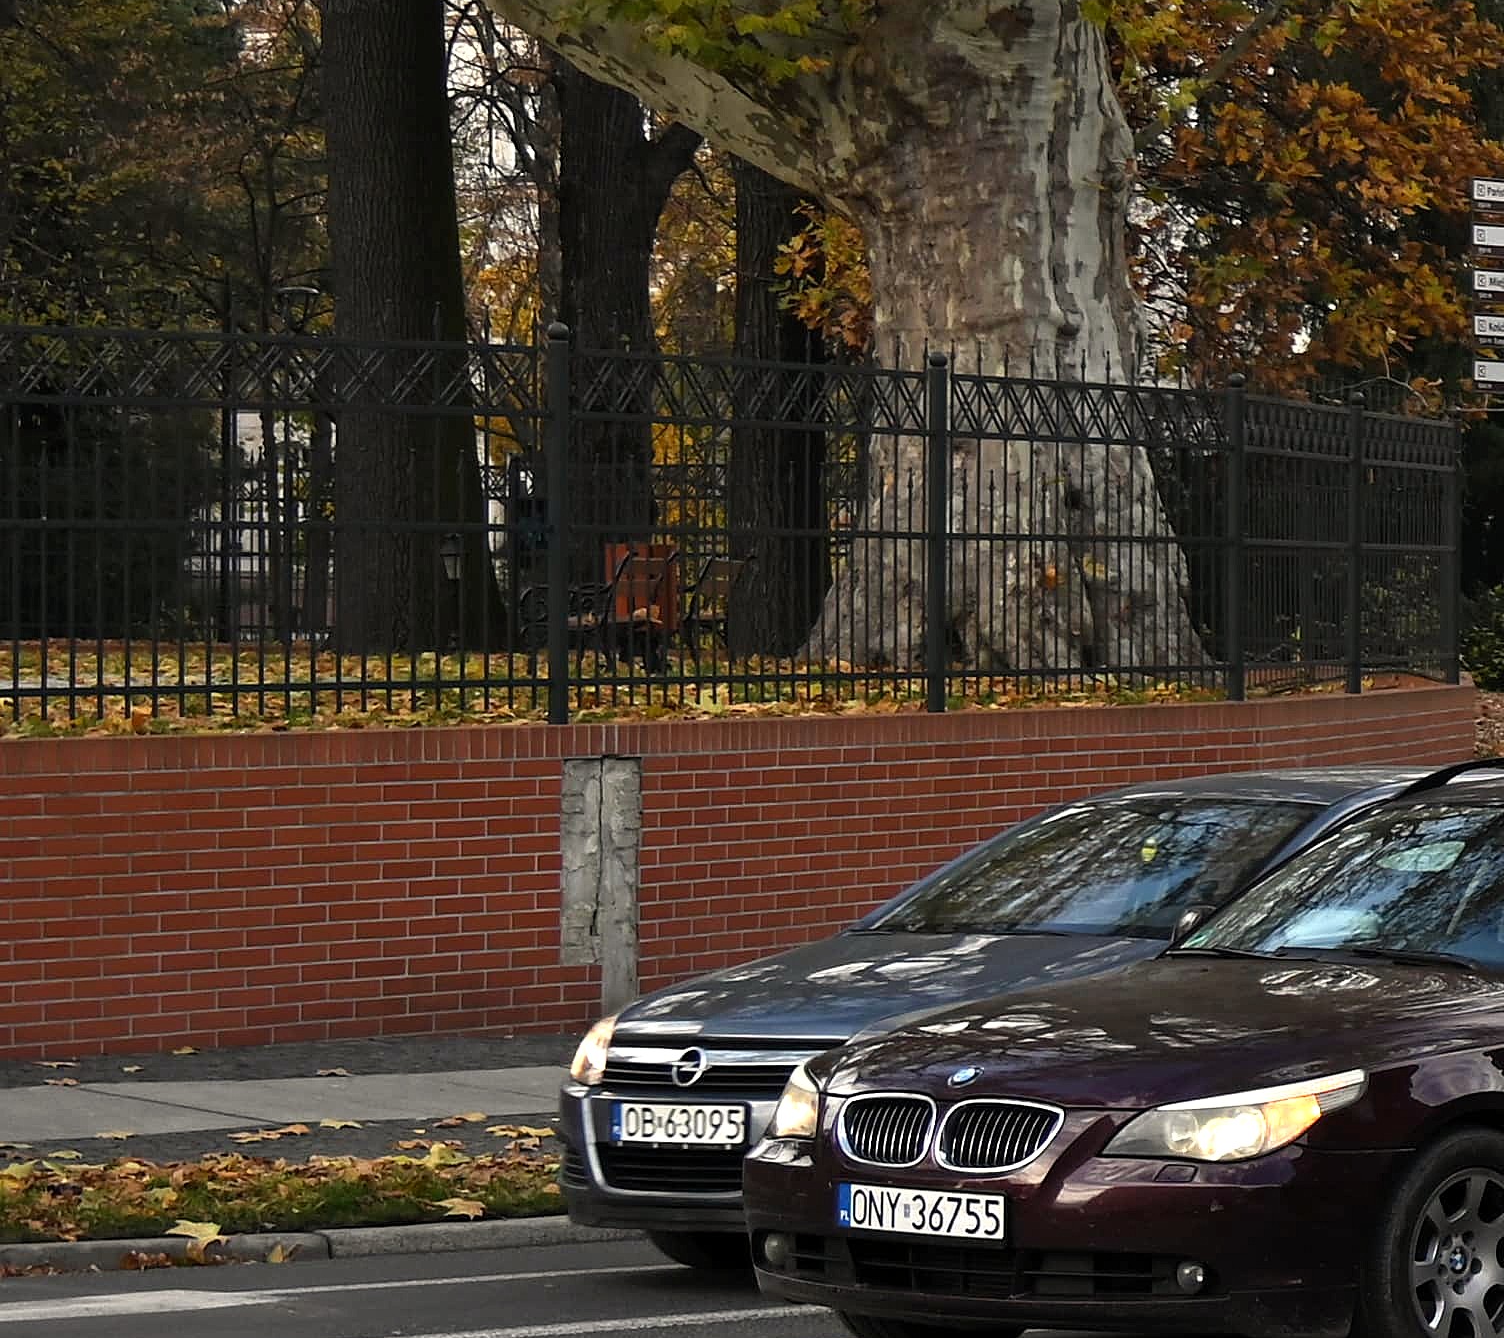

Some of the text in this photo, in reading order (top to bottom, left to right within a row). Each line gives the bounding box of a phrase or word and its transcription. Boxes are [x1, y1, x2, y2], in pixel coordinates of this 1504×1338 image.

[626, 1107, 741, 1140] OB 63095
[853, 1189, 901, 1228] ONY
[912, 1194, 999, 1236] 36755
